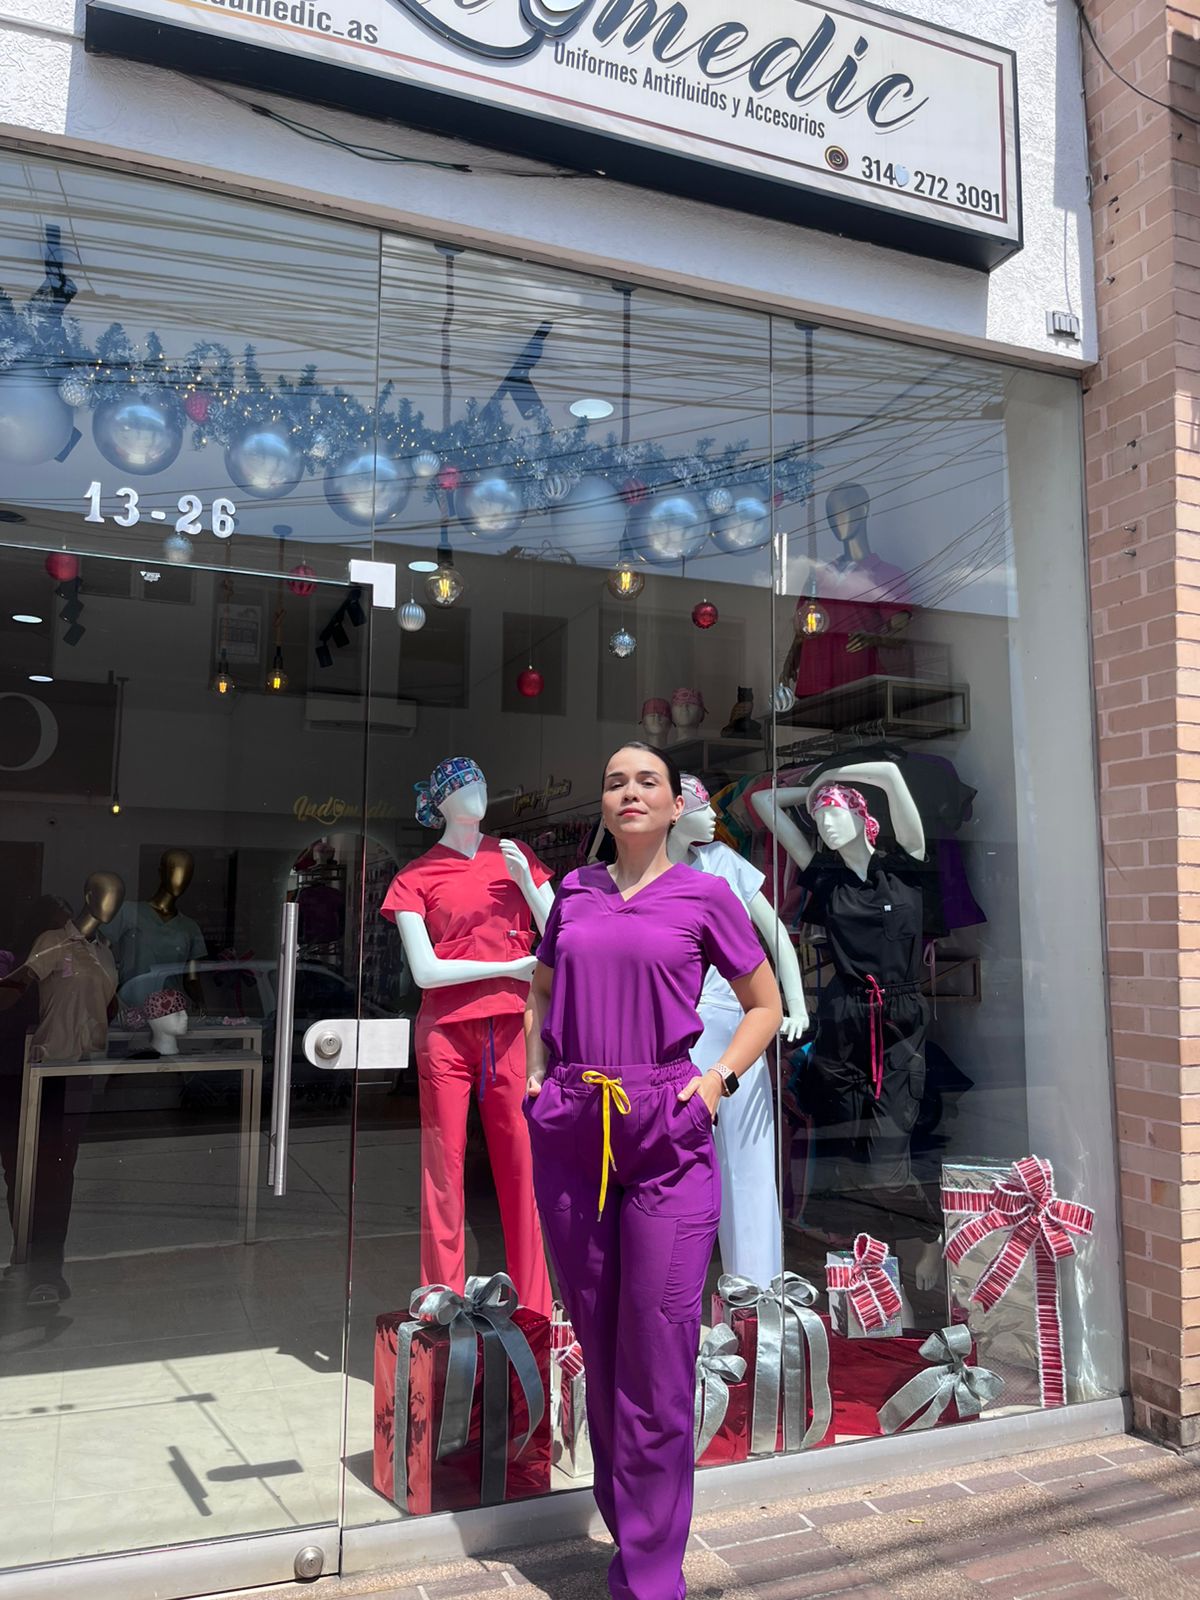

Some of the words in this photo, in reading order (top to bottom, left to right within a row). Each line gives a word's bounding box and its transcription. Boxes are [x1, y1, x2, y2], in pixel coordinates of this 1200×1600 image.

[553, 41, 637, 85] Uniformes
[643, 66, 727, 110] Antifluidos
[732, 96, 741, 118] y
[745, 96, 825, 139] Accesorios
[914, 170, 949, 200] 272
[956, 182, 1000, 214] 3091
[83, 481, 236, 539] 13-26
